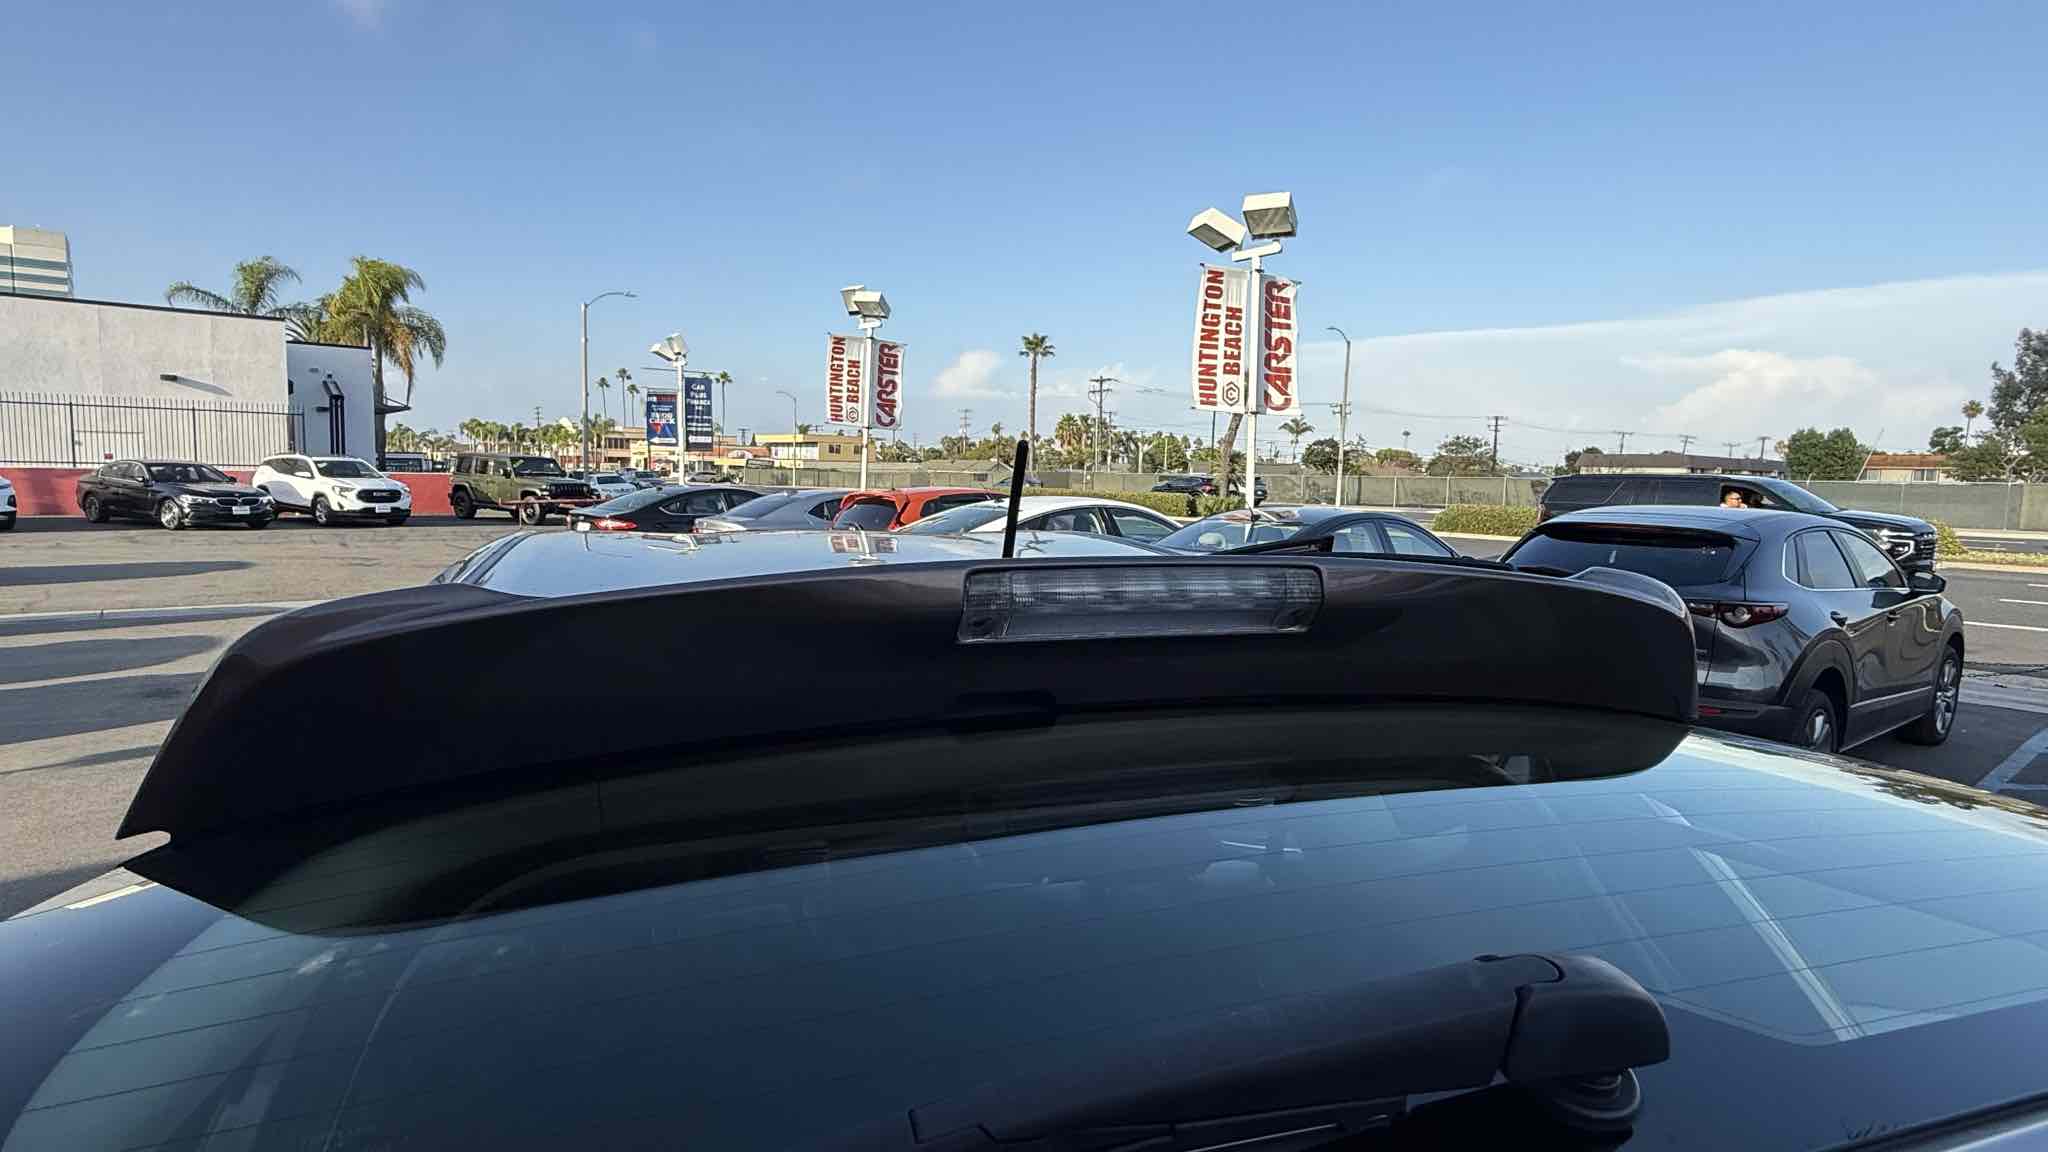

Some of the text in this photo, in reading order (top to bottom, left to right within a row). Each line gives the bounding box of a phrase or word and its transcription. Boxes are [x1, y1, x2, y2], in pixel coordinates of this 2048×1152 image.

[829, 337, 846, 422] HUNTINGTON
[1198, 269, 1225, 407] HUNTINGTON
[1222, 306, 1243, 376] BEACH
[1264, 280, 1292, 412] CARSTER
[846, 359, 861, 404] BEACH
[876, 343, 898, 427] CARSTER
